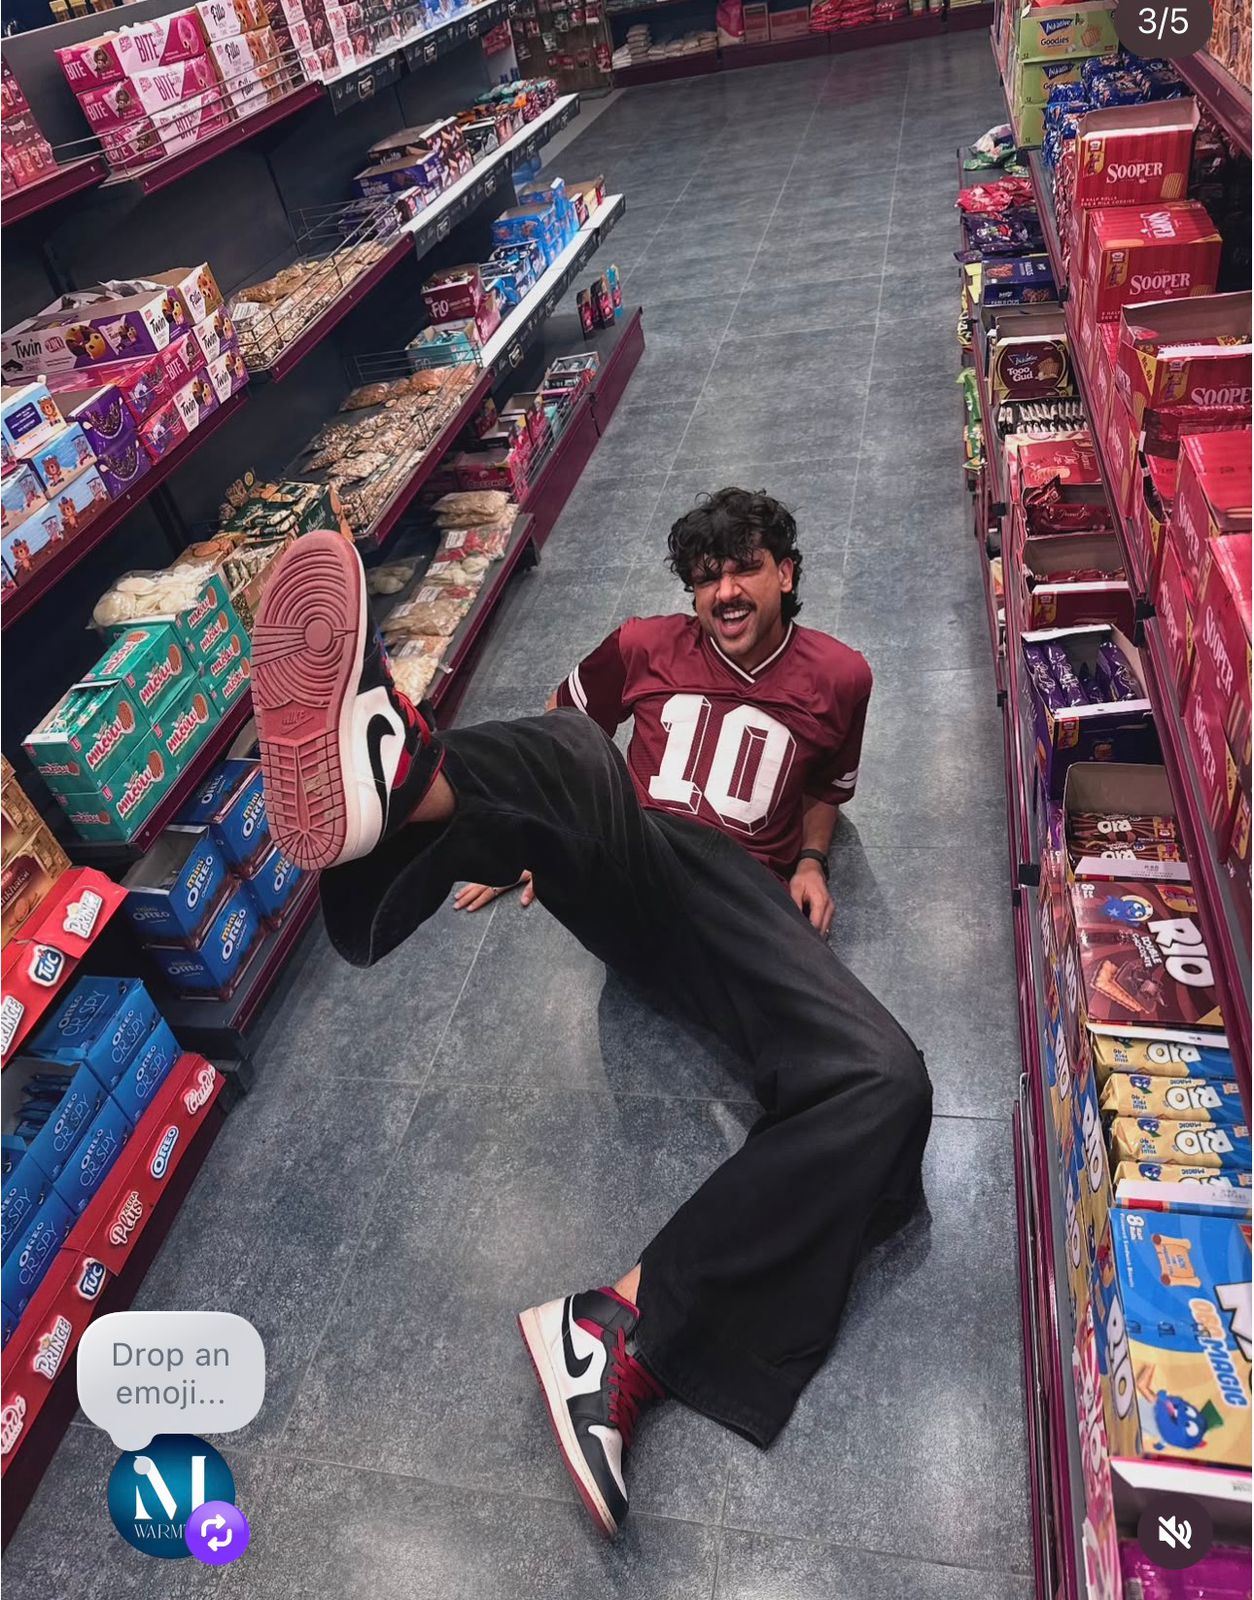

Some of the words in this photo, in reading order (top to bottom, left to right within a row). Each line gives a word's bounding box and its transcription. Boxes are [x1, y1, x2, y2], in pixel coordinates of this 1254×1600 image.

[134, 33, 160, 63] BITE
[1040, 36, 1069, 46] Goodies
[64, 62, 87, 81] BITE
[153, 74, 180, 101] BITE
[86, 101, 108, 121] BITE
[1106, 162, 1164, 184] SOOPER
[1129, 272, 1190, 295] SOOPER
[149, 316, 167, 336] Twin
[201, 331, 218, 350] Twin
[11, 338, 42, 359] Twin
[166, 358, 184, 380] BITE
[214, 371, 229, 388] Twin
[1007, 367, 1030, 376] Tooo
[1012, 371, 1034, 382] Gud
[181, 398, 196, 417] Twin
[1203, 605, 1234, 696] SOOPER
[648, 694, 797, 835] 10
[242, 791, 261, 820] mini
[242, 792, 265, 837] ORE
[1097, 819, 1132, 834] RIO
[187, 857, 204, 888] mini
[187, 856, 213, 908] OREO
[1081, 883, 1096, 891] 8
[69, 892, 100, 938] PRINCE
[222, 912, 238, 942] mini
[222, 909, 246, 960] OREO
[1132, 933, 1153, 968] CHOCOLATE
[1141, 936, 1162, 965] DOUBLE
[1147, 918, 1215, 988] RIO
[38, 953, 59, 980] TUC
[1, 997, 24, 1054] RINCE
[112, 1010, 134, 1046] OREO
[136, 1045, 157, 1081] OREO
[1147, 1041, 1202, 1064] RIO
[1165, 1086, 1223, 1111] RIO
[54, 1093, 78, 1135] OREO
[81, 1129, 104, 1170] OREO
[153, 1128, 177, 1176] OREO
[1082, 1095, 1104, 1192] RIO
[1174, 1129, 1234, 1156] RIO
[122, 1192, 139, 1216] ZEERA
[112, 1201, 143, 1243] Plus
[1126, 1214, 1145, 1227] 8
[18, 1222, 44, 1268] OREO
[82, 1263, 104, 1296] TUC
[36, 1318, 71, 1380] PRINCE
[1107, 1295, 1132, 1420] RIO
[1200, 1339, 1248, 1407] MAGIC
